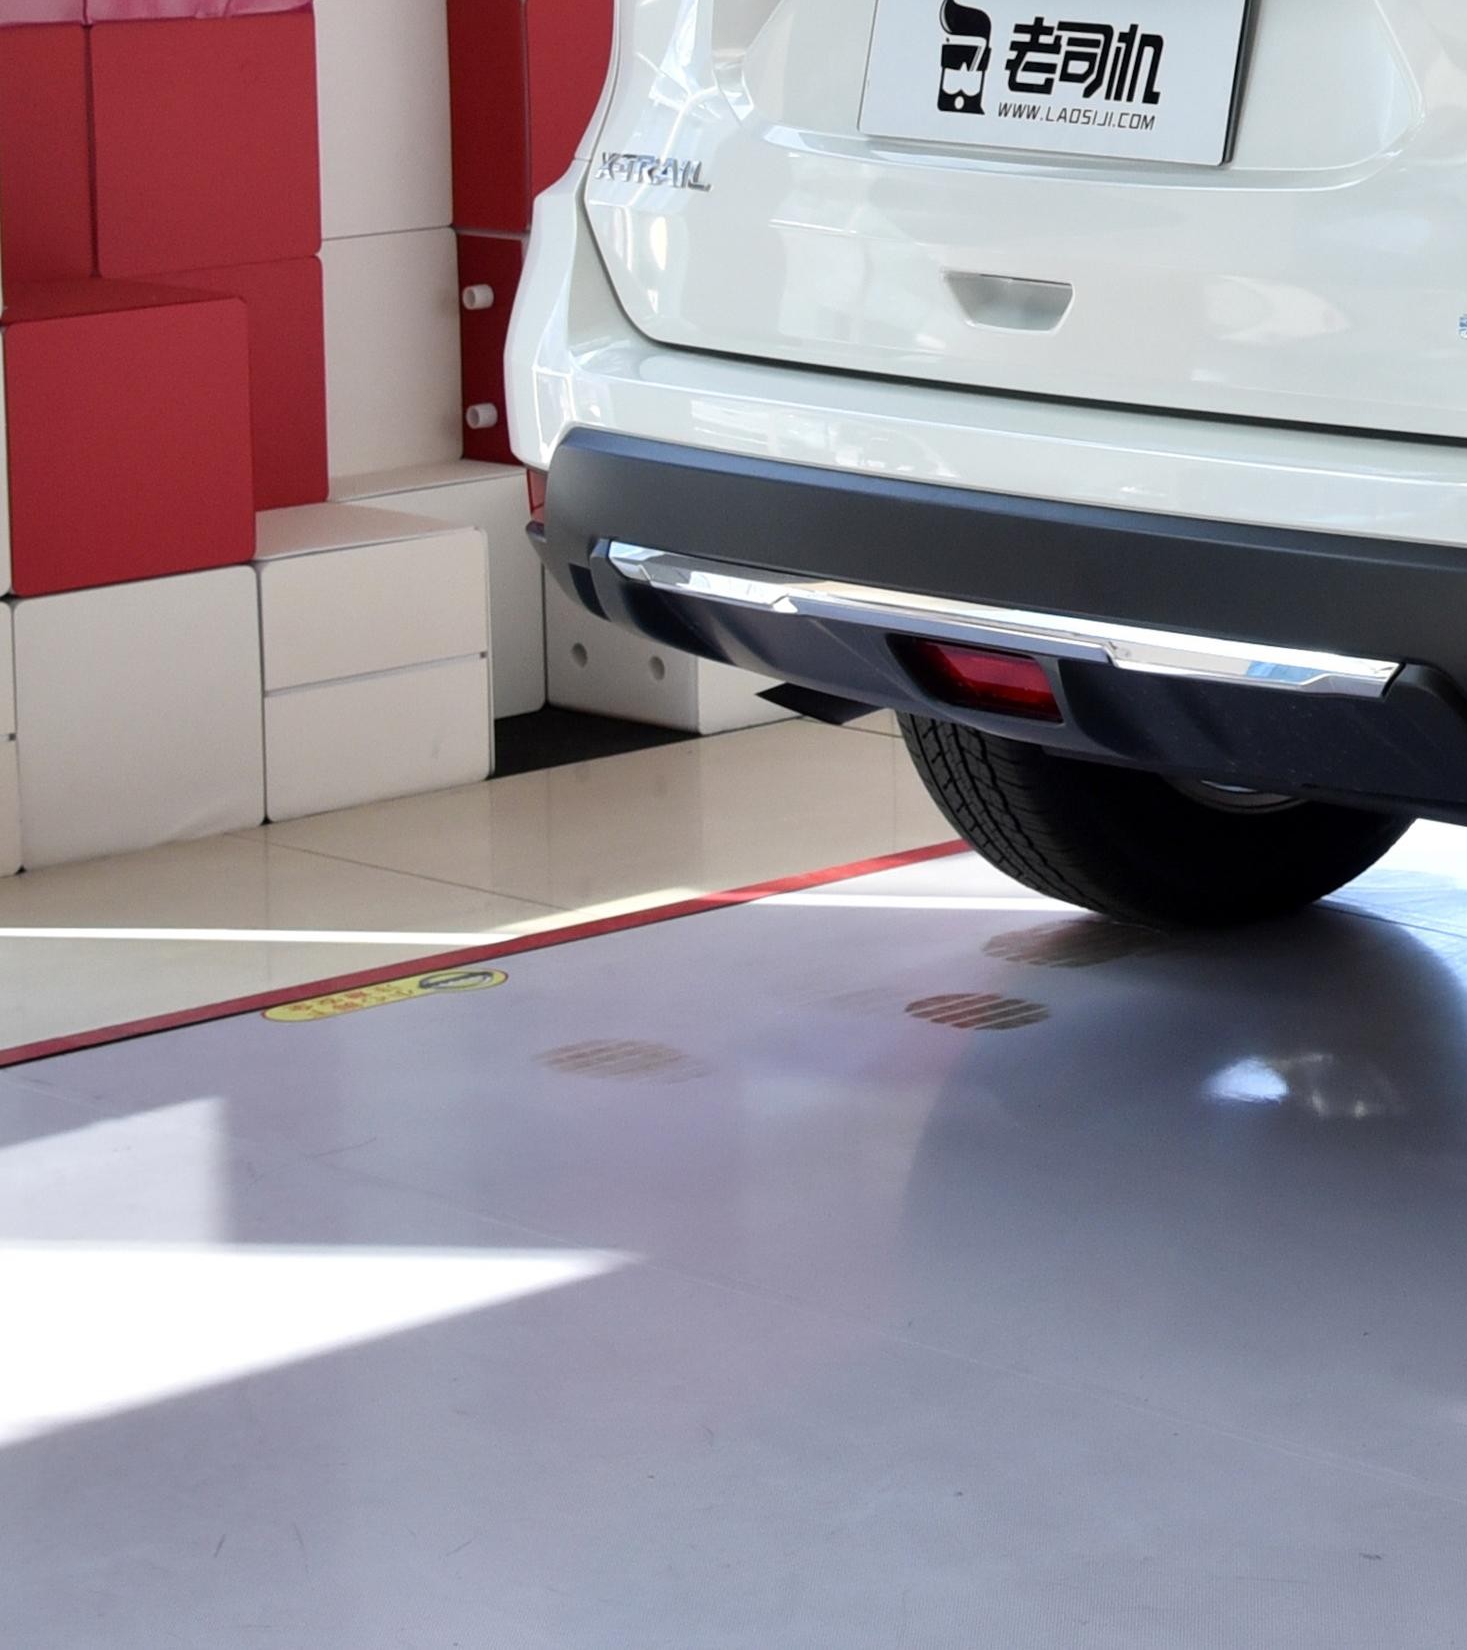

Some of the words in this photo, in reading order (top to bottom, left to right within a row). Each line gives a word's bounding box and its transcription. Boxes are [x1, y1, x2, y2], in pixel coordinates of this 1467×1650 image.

[1004, 17, 1164, 104] 老司机
[997, 101, 1157, 131] WWW.LAOSIJI.COM
[595, 152, 712, 192] X-TRAIL
